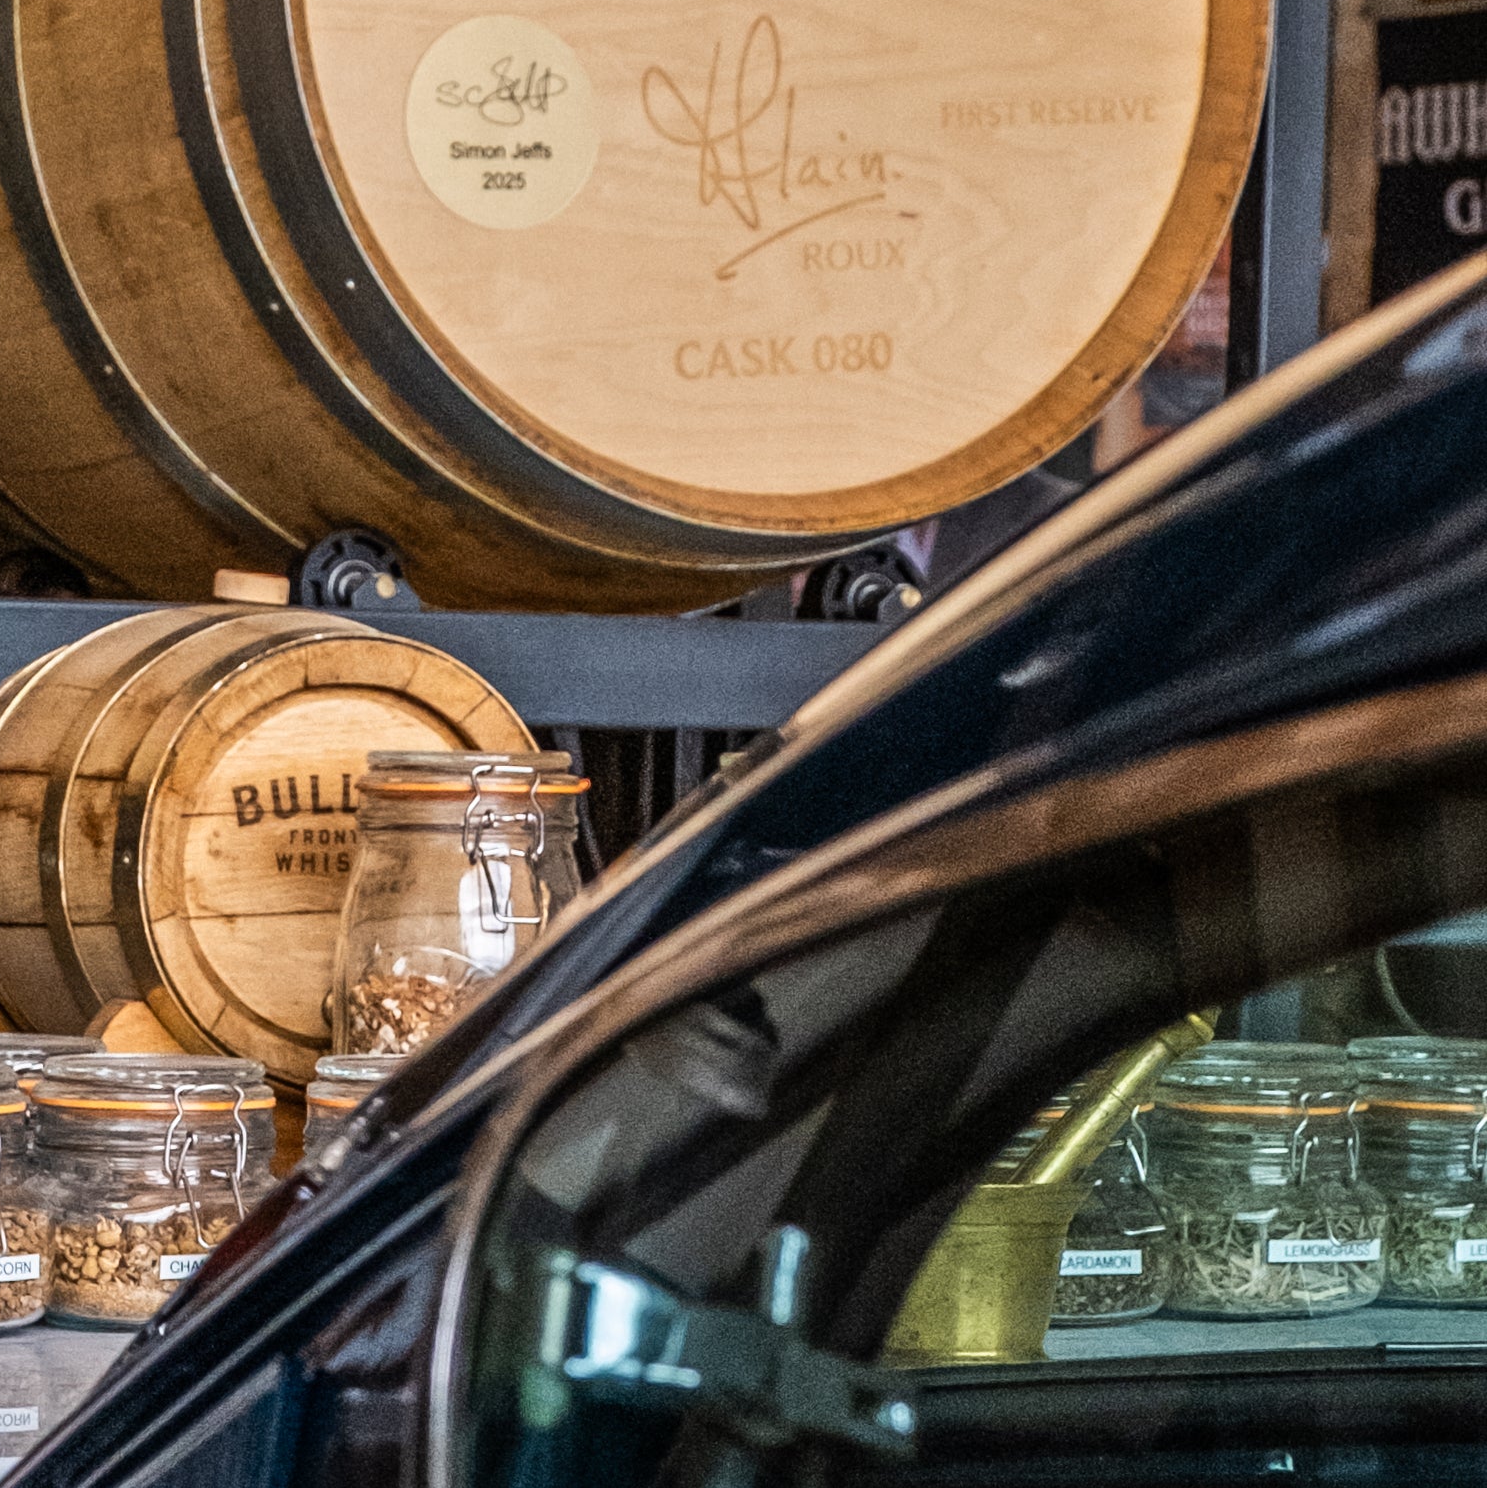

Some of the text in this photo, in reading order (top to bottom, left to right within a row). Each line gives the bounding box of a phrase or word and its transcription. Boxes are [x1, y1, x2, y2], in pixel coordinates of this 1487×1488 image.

[940, 96, 1157, 128] FIRST RESERVE
[450, 141, 553, 159] Simon Jeffs
[482, 171, 527, 190] 2025
[802, 239, 908, 274] ROUX
[674, 333, 893, 381] CASK 080
[1284, 1243, 1370, 1257] LEMONGRASS
